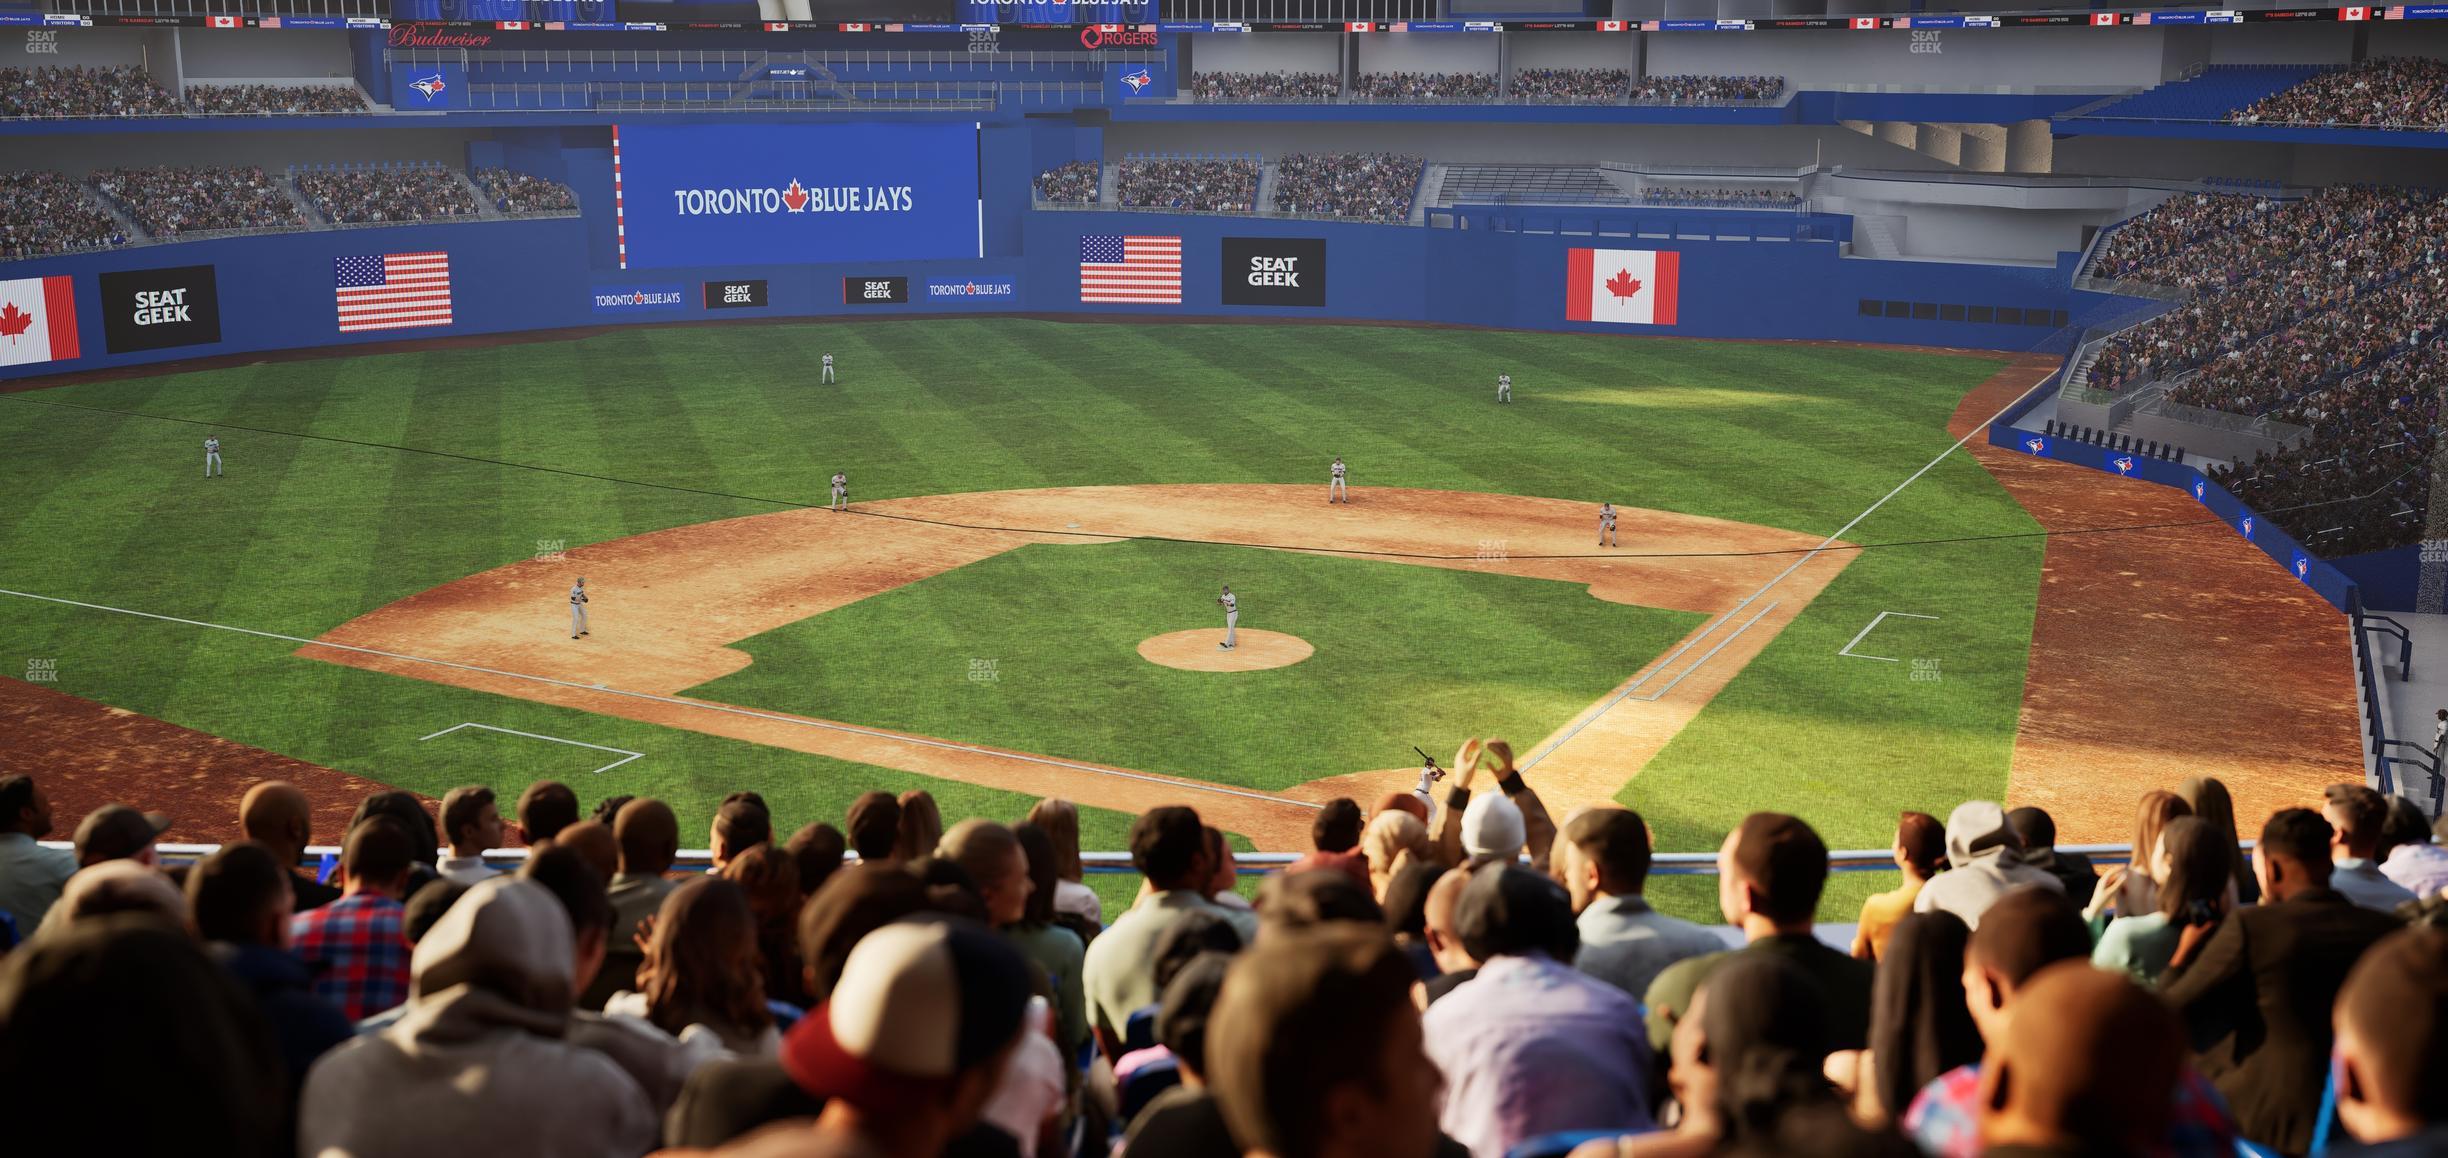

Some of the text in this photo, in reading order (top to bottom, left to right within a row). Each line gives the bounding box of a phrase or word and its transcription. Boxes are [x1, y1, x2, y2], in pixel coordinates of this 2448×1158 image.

[389, 23, 491, 47] Budweiser
[1104, 33, 1158, 45] ROGERS
[675, 186, 913, 215] TORONTO BLUE JAYS
[1251, 256, 1298, 272] SEAT
[865, 281, 890, 290] SEAT
[1248, 272, 1300, 287] GEEK
[725, 285, 750, 294] SEAT
[863, 289, 892, 299] GEEK
[929, 284, 1011, 295] TORONTO BLUE JAYS
[134, 288, 187, 309] SEAT
[595, 292, 681, 306] TORONTO BLUE JAYS
[723, 293, 752, 303] GEEK
[133, 305, 192, 325] GEEK
